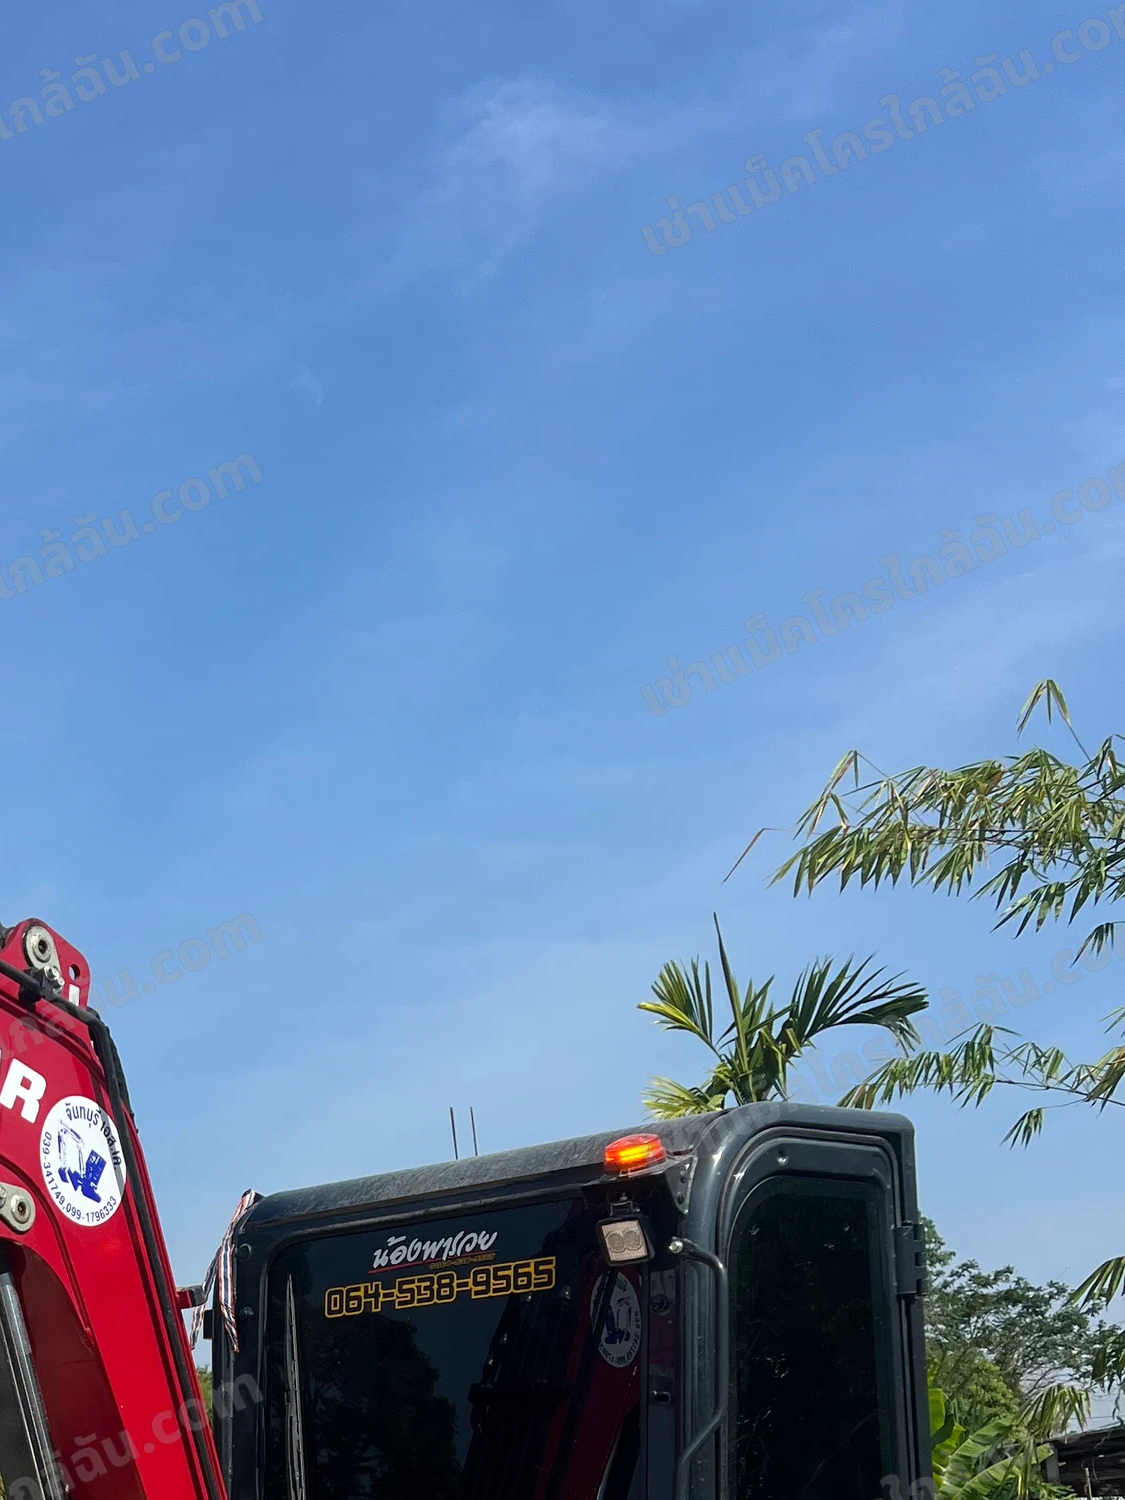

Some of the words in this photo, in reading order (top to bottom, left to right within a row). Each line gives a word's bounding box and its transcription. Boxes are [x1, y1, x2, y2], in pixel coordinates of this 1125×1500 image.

[65, 1102, 102, 1129] จันทบุรี
[324, 1255, 557, 1319] 064-538-9565
